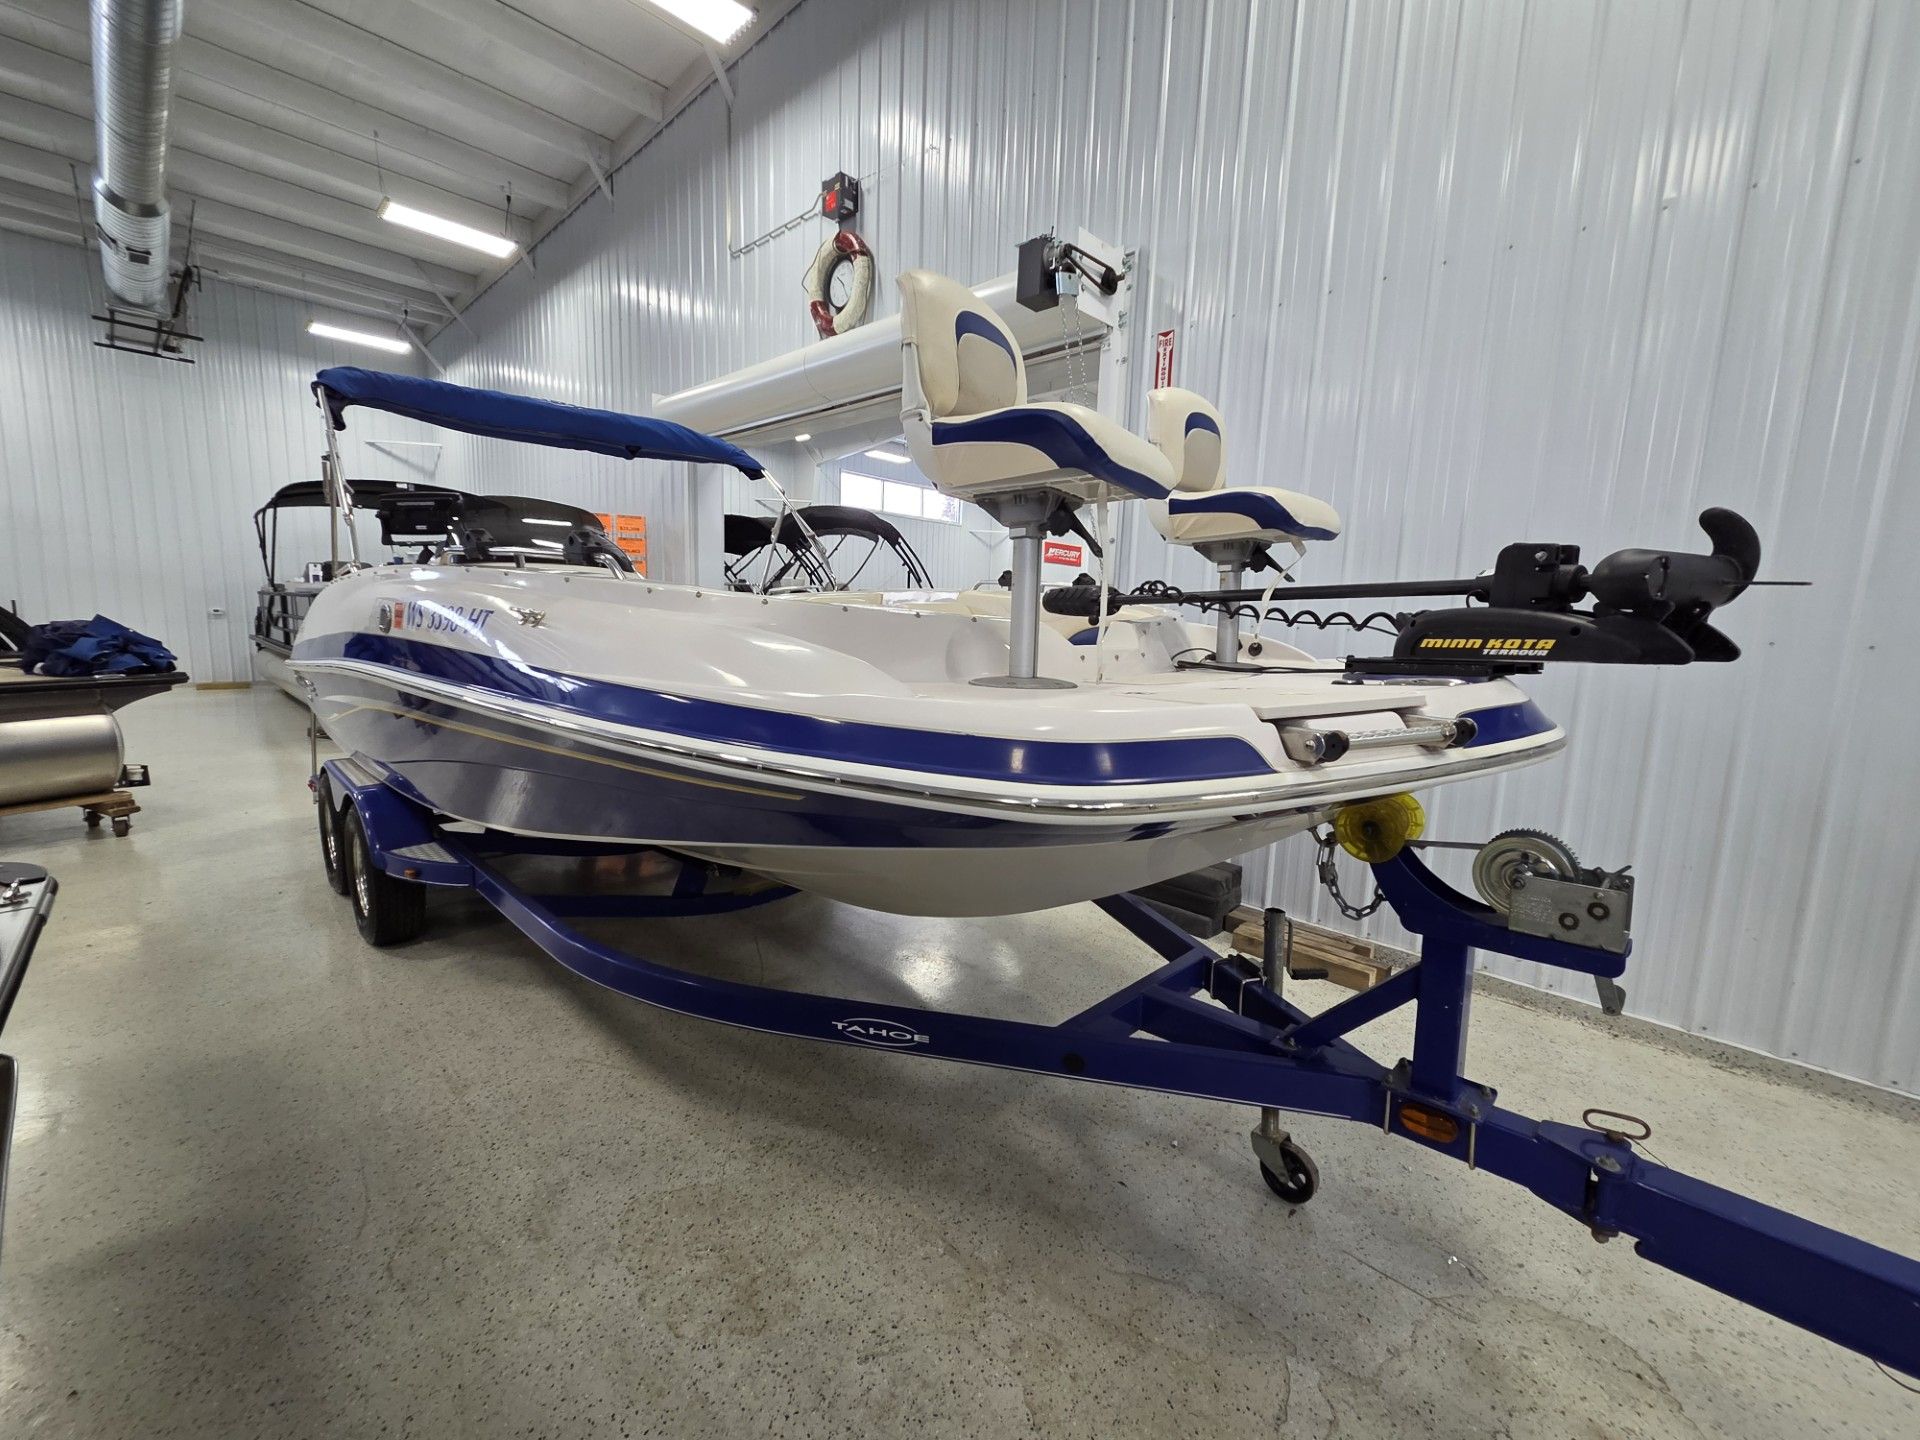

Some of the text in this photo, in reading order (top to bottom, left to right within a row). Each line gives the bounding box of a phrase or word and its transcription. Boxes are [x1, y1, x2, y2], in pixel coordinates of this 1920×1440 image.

[1158, 337, 1172, 347] FIRE
[1046, 547, 1081, 559] MERCURY
[407, 601, 424, 628] WS
[463, 608, 495, 634] HT
[1485, 638, 1557, 649] KOTA
[1482, 648, 1550, 656] TERROVA
[831, 1021, 930, 1044] TAHOE
